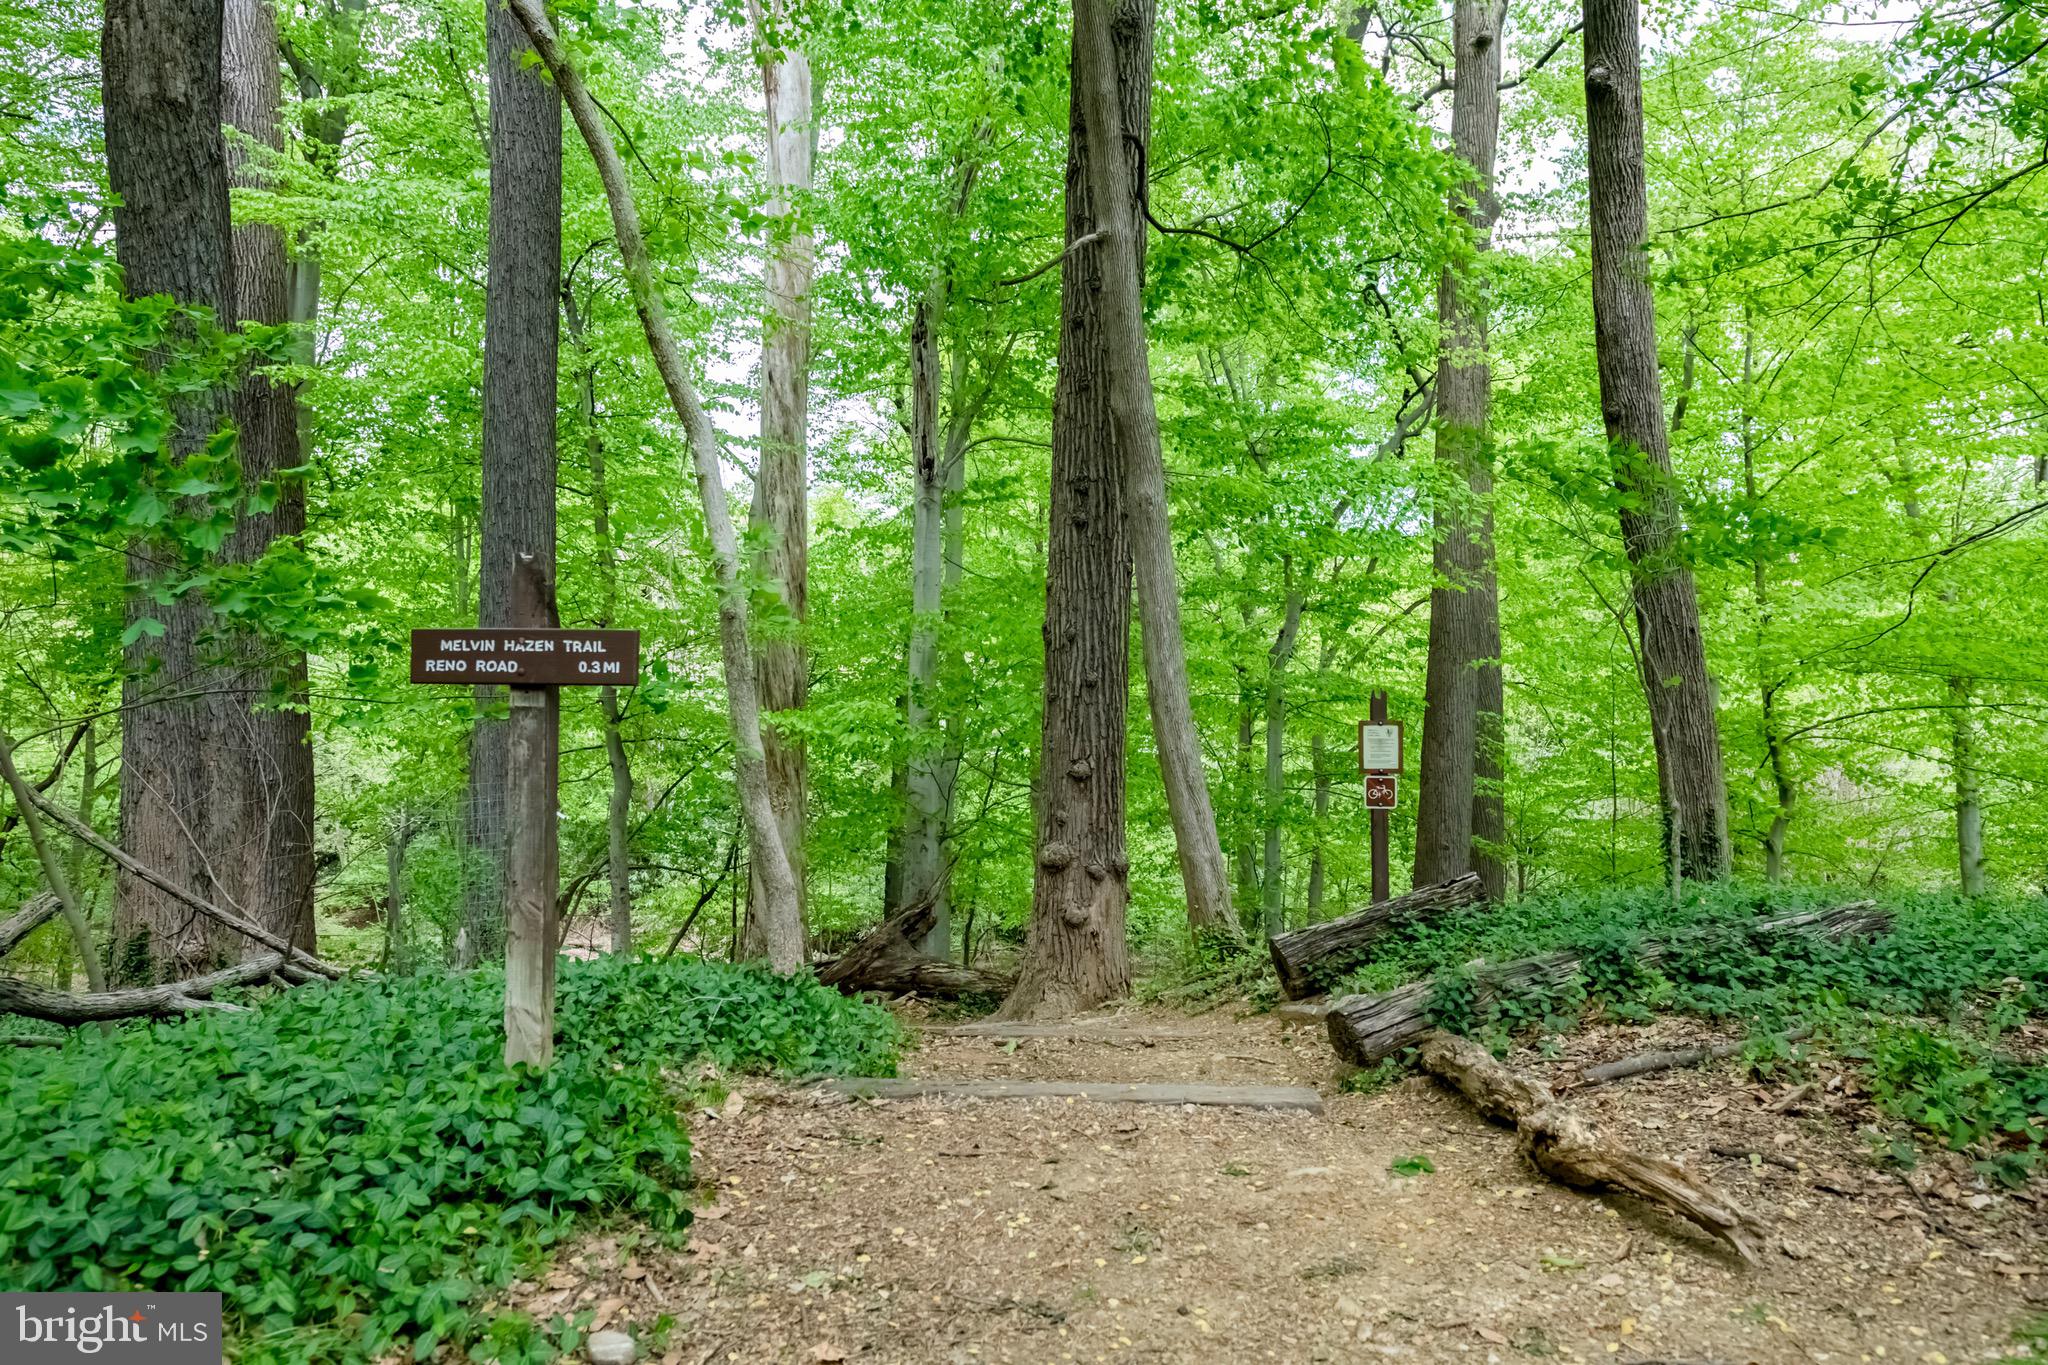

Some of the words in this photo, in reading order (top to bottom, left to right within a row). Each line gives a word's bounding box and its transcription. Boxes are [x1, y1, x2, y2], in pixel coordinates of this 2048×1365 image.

[440, 639, 495, 652] MELVIN
[503, 639, 554, 652] HAZEN
[562, 639, 607, 653] TRAIL
[425, 659, 467, 672] RENO
[475, 659, 518, 673] ROAD
